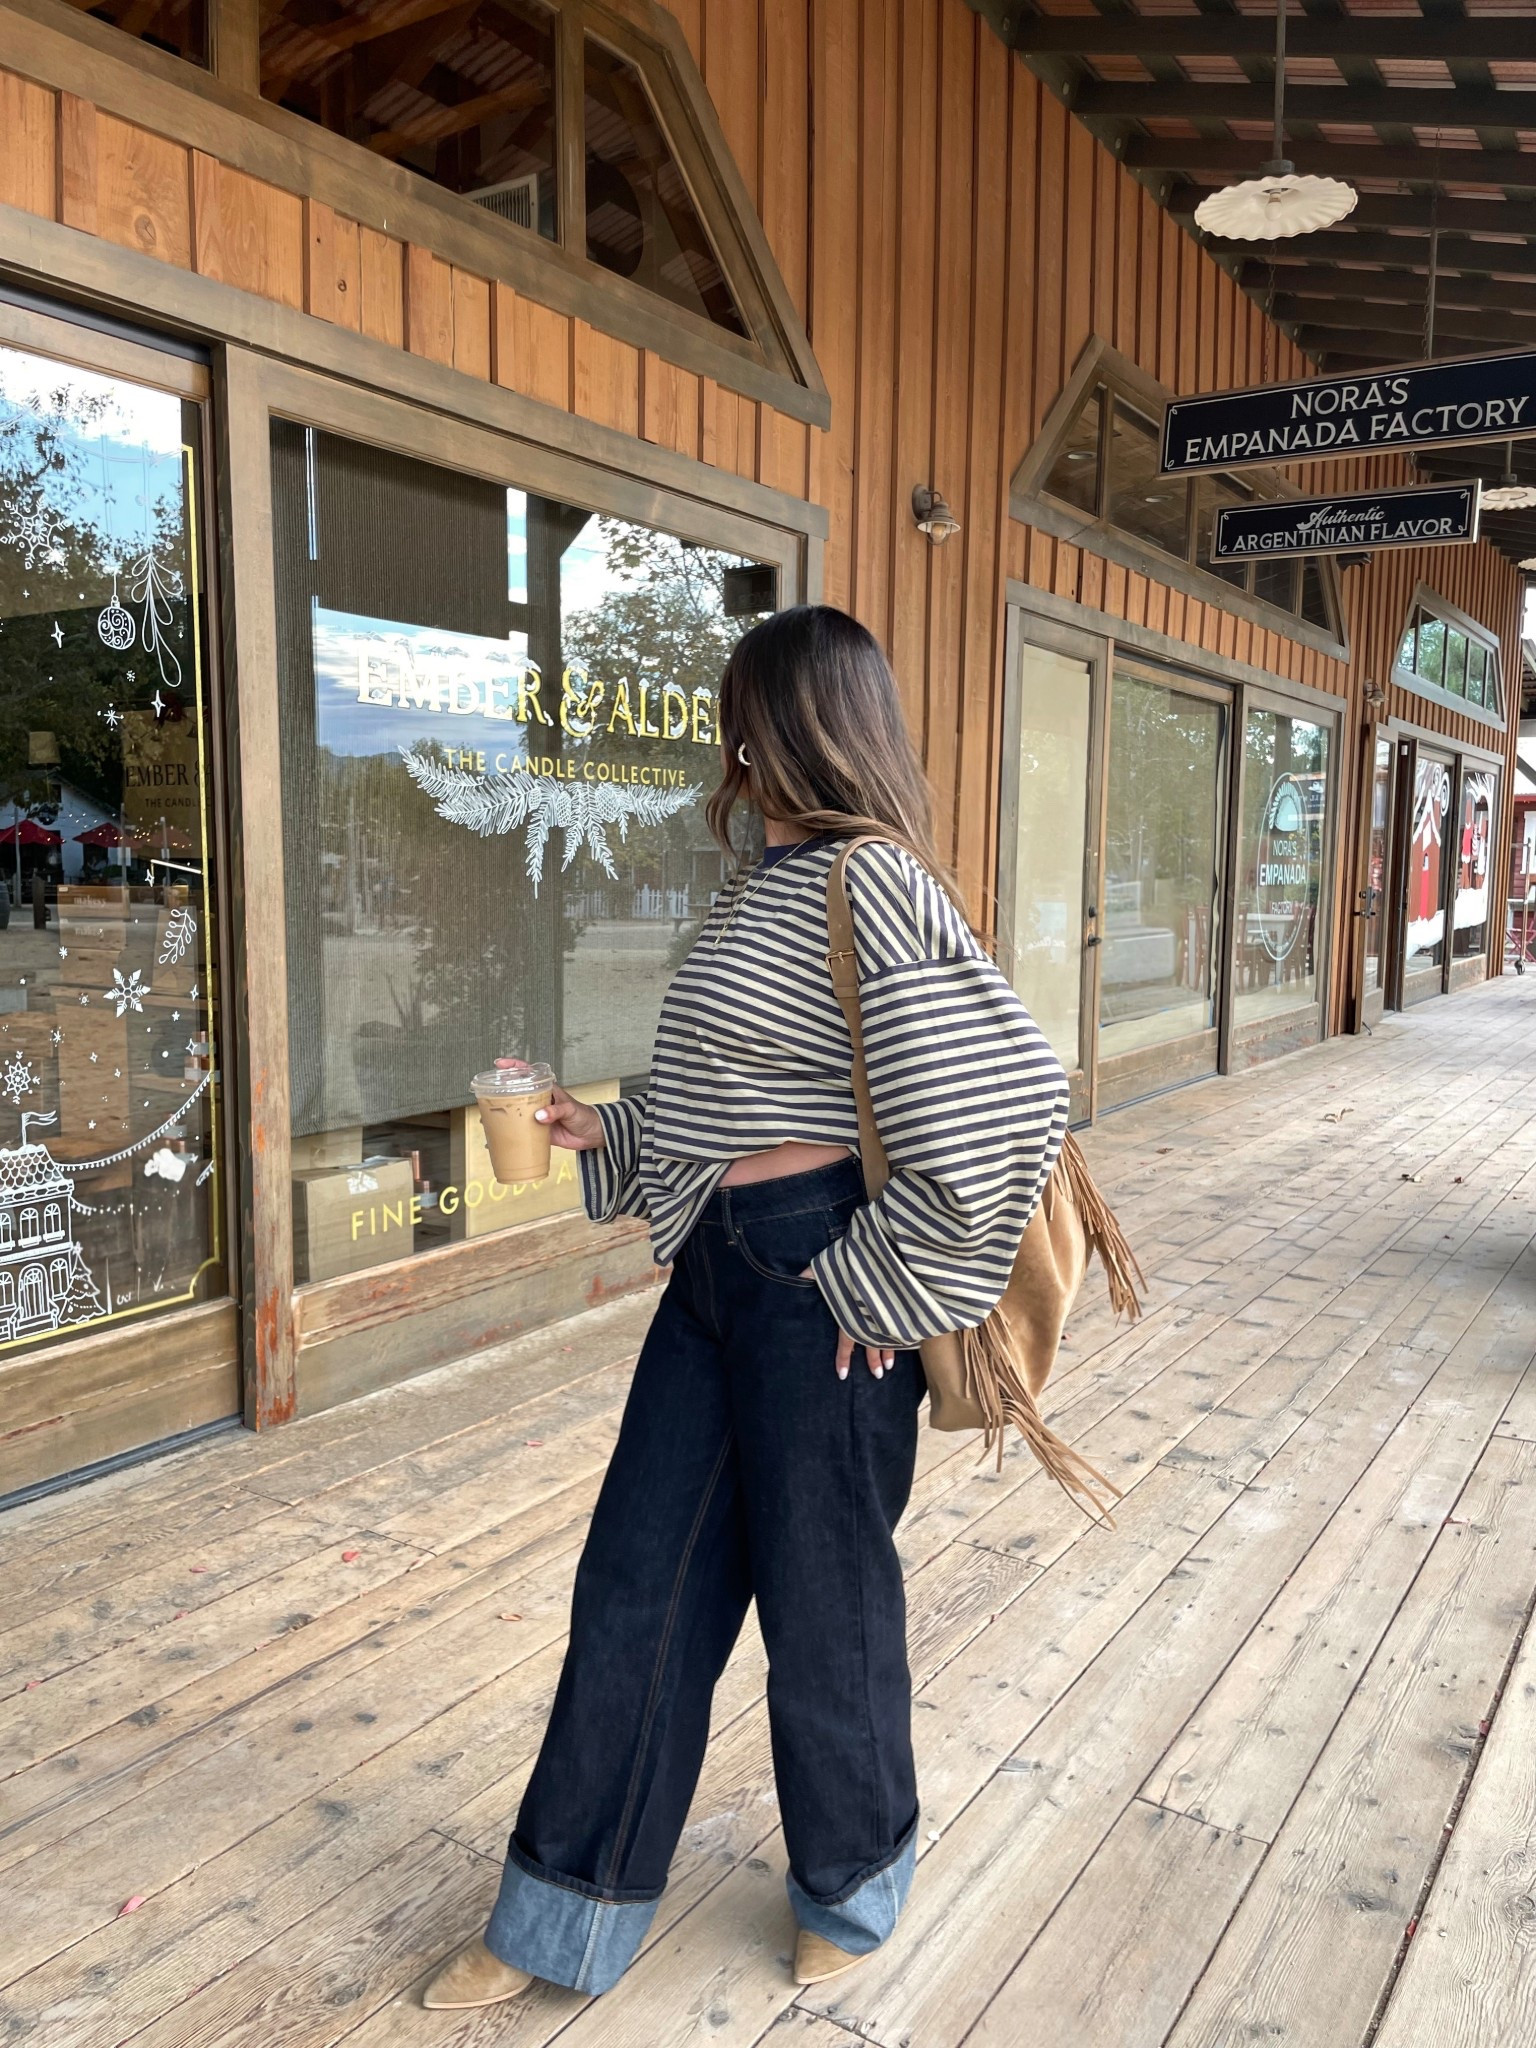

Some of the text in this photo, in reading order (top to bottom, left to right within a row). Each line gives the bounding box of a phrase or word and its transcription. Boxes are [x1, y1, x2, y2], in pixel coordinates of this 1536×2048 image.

[1290, 377, 1410, 420] NORA'S
[1184, 395, 1530, 464] EMPANADA FACTORY
[1232, 517, 1452, 551] ARGENTINIAN FLAVOR
[1296, 505, 1385, 530] Authentic
[357, 640, 722, 746] EMBER & ALDE
[125, 763, 189, 787] EMBER
[443, 748, 686, 787] THE CANDLE COLLECTIVE
[145, 798, 162, 808] THE
[165, 797, 200, 808] CANDL
[1272, 840, 1297, 856] NORA'S
[1259, 863, 1307, 886] EMPANADA
[351, 1195, 423, 1241] FINE
